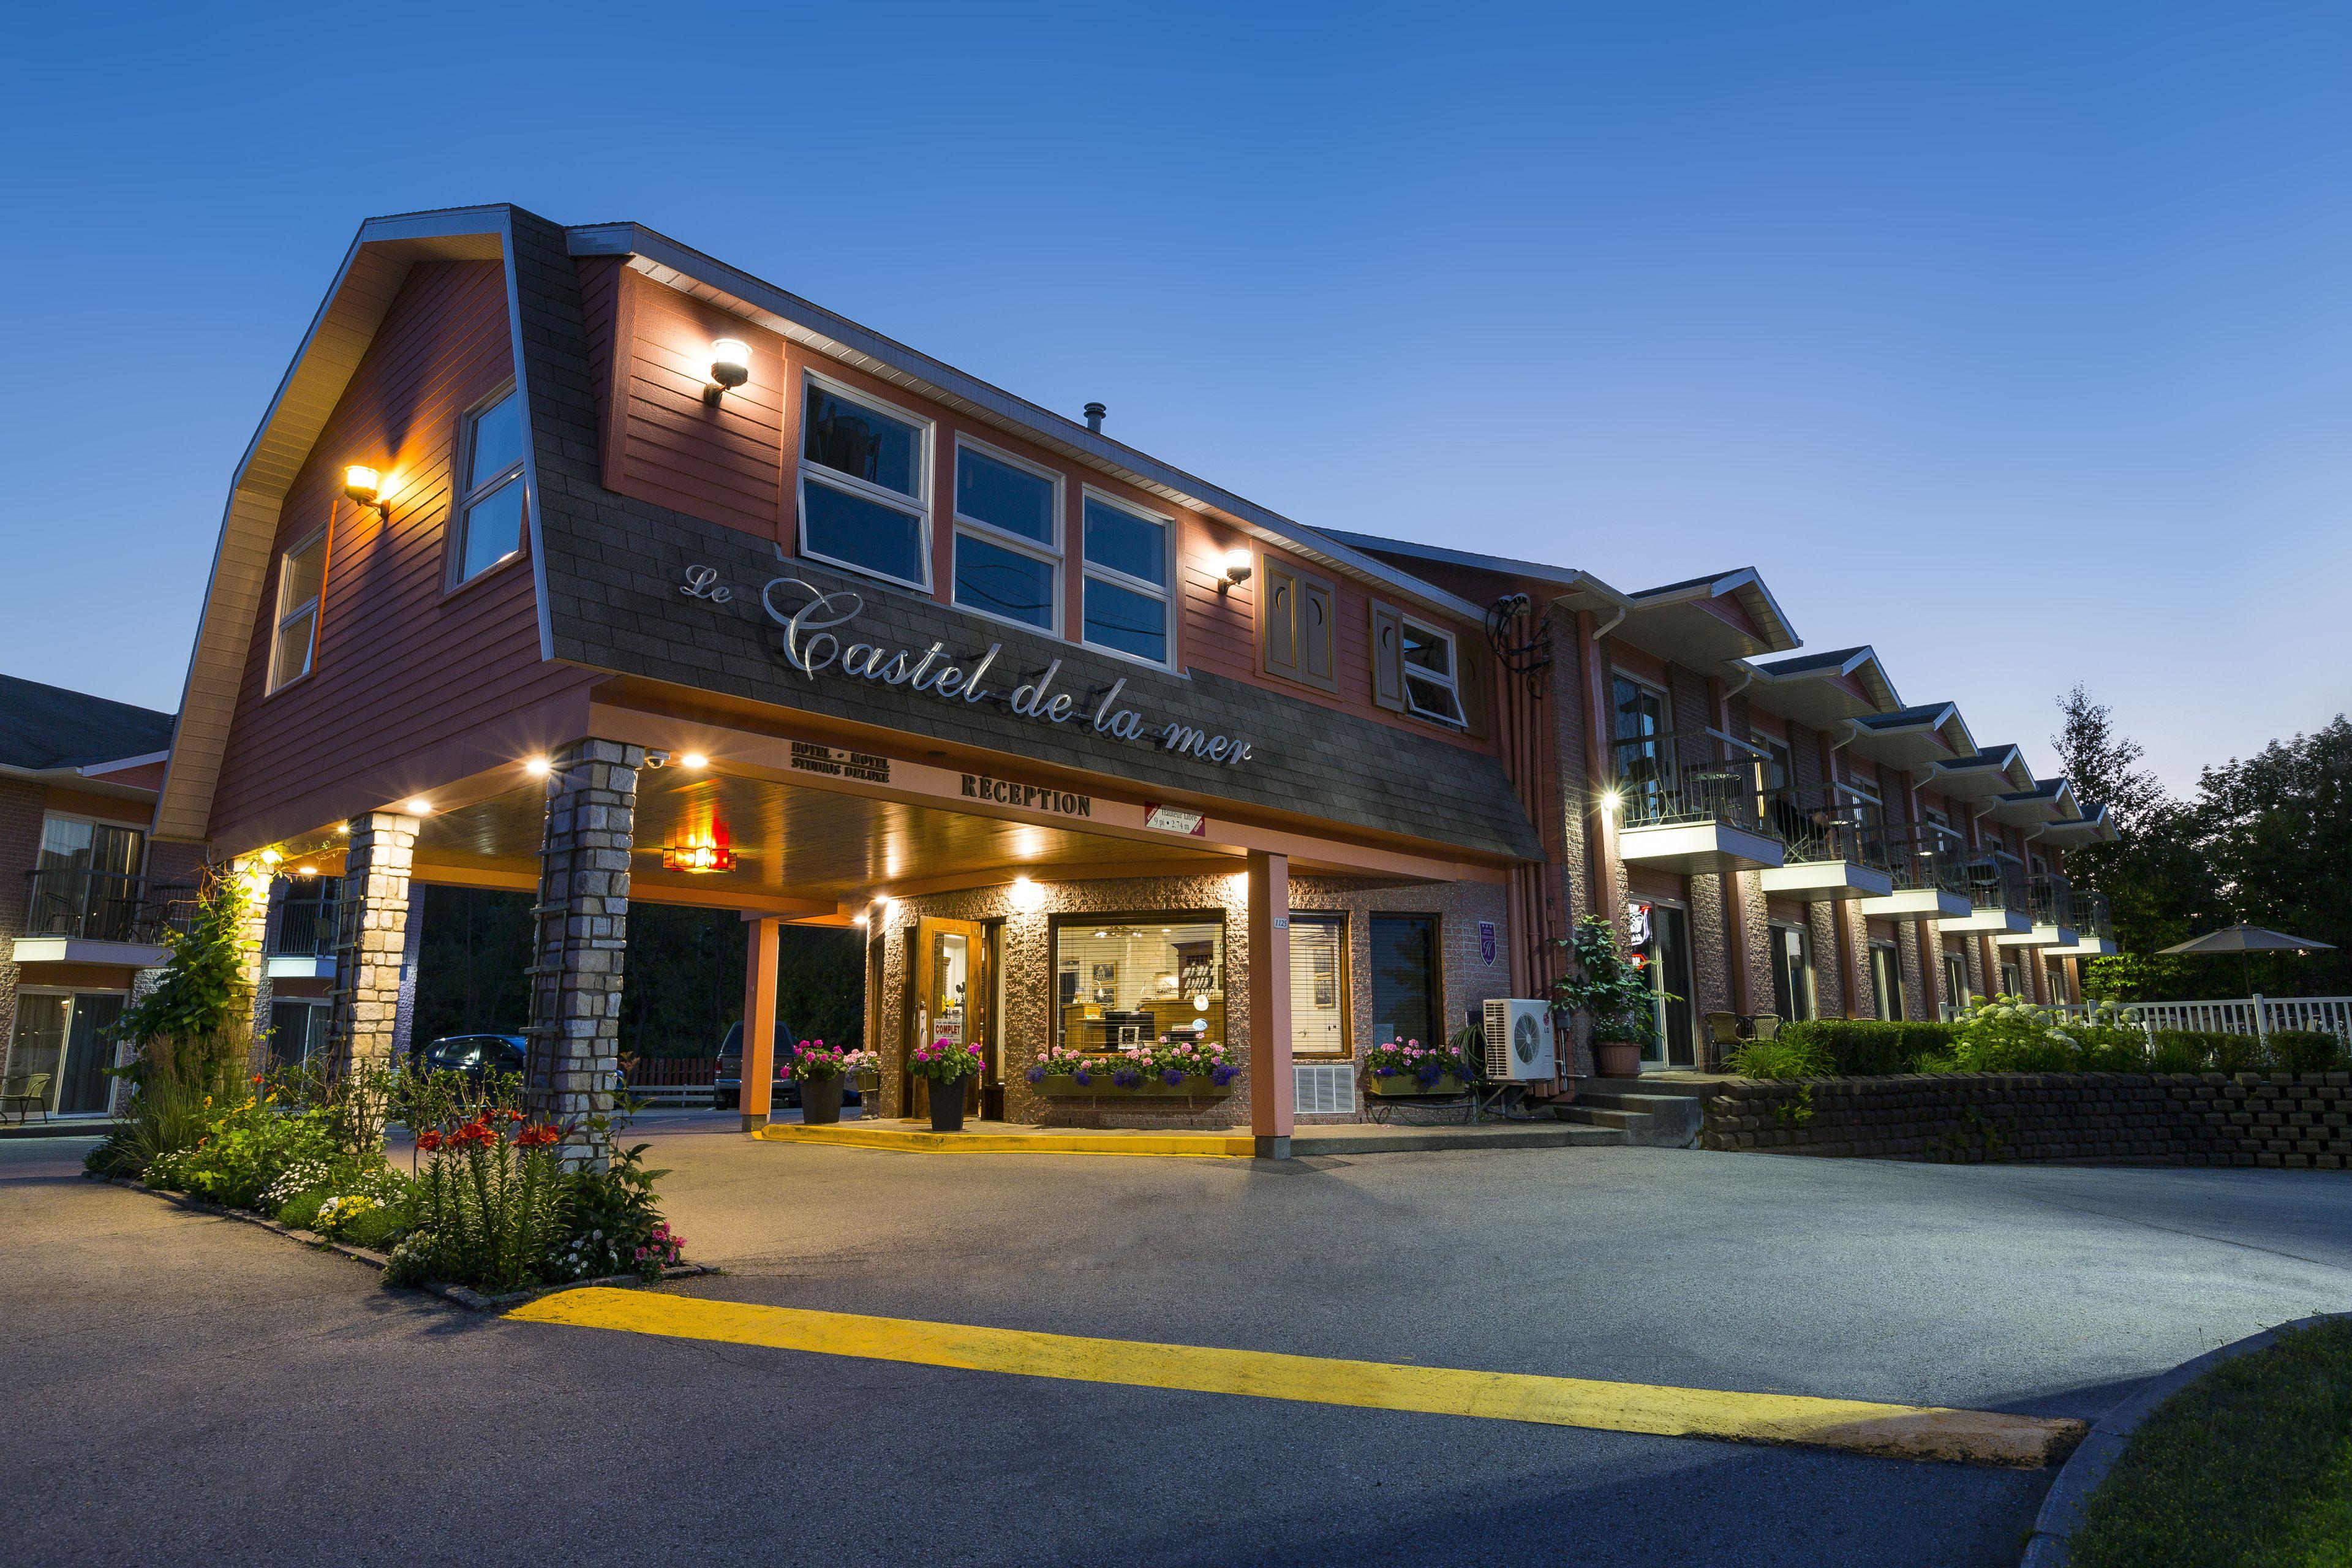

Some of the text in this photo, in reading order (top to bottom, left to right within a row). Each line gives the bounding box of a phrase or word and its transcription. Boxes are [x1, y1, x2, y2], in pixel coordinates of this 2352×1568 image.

[679, 565, 1252, 764] Le Castel de la mer
[850, 752, 891, 769] MOTEL
[791, 757, 890, 783] STUDIOS DELUXE
[960, 774, 1091, 817] RÉCEPTION
[1154, 816, 1158, 826] 9
[1159, 818, 1165, 827] pi
[1171, 820, 1183, 829] 2.74
[1161, 808, 1197, 822] Hauteur Libre
[935, 1024, 960, 1034] COMPLET
